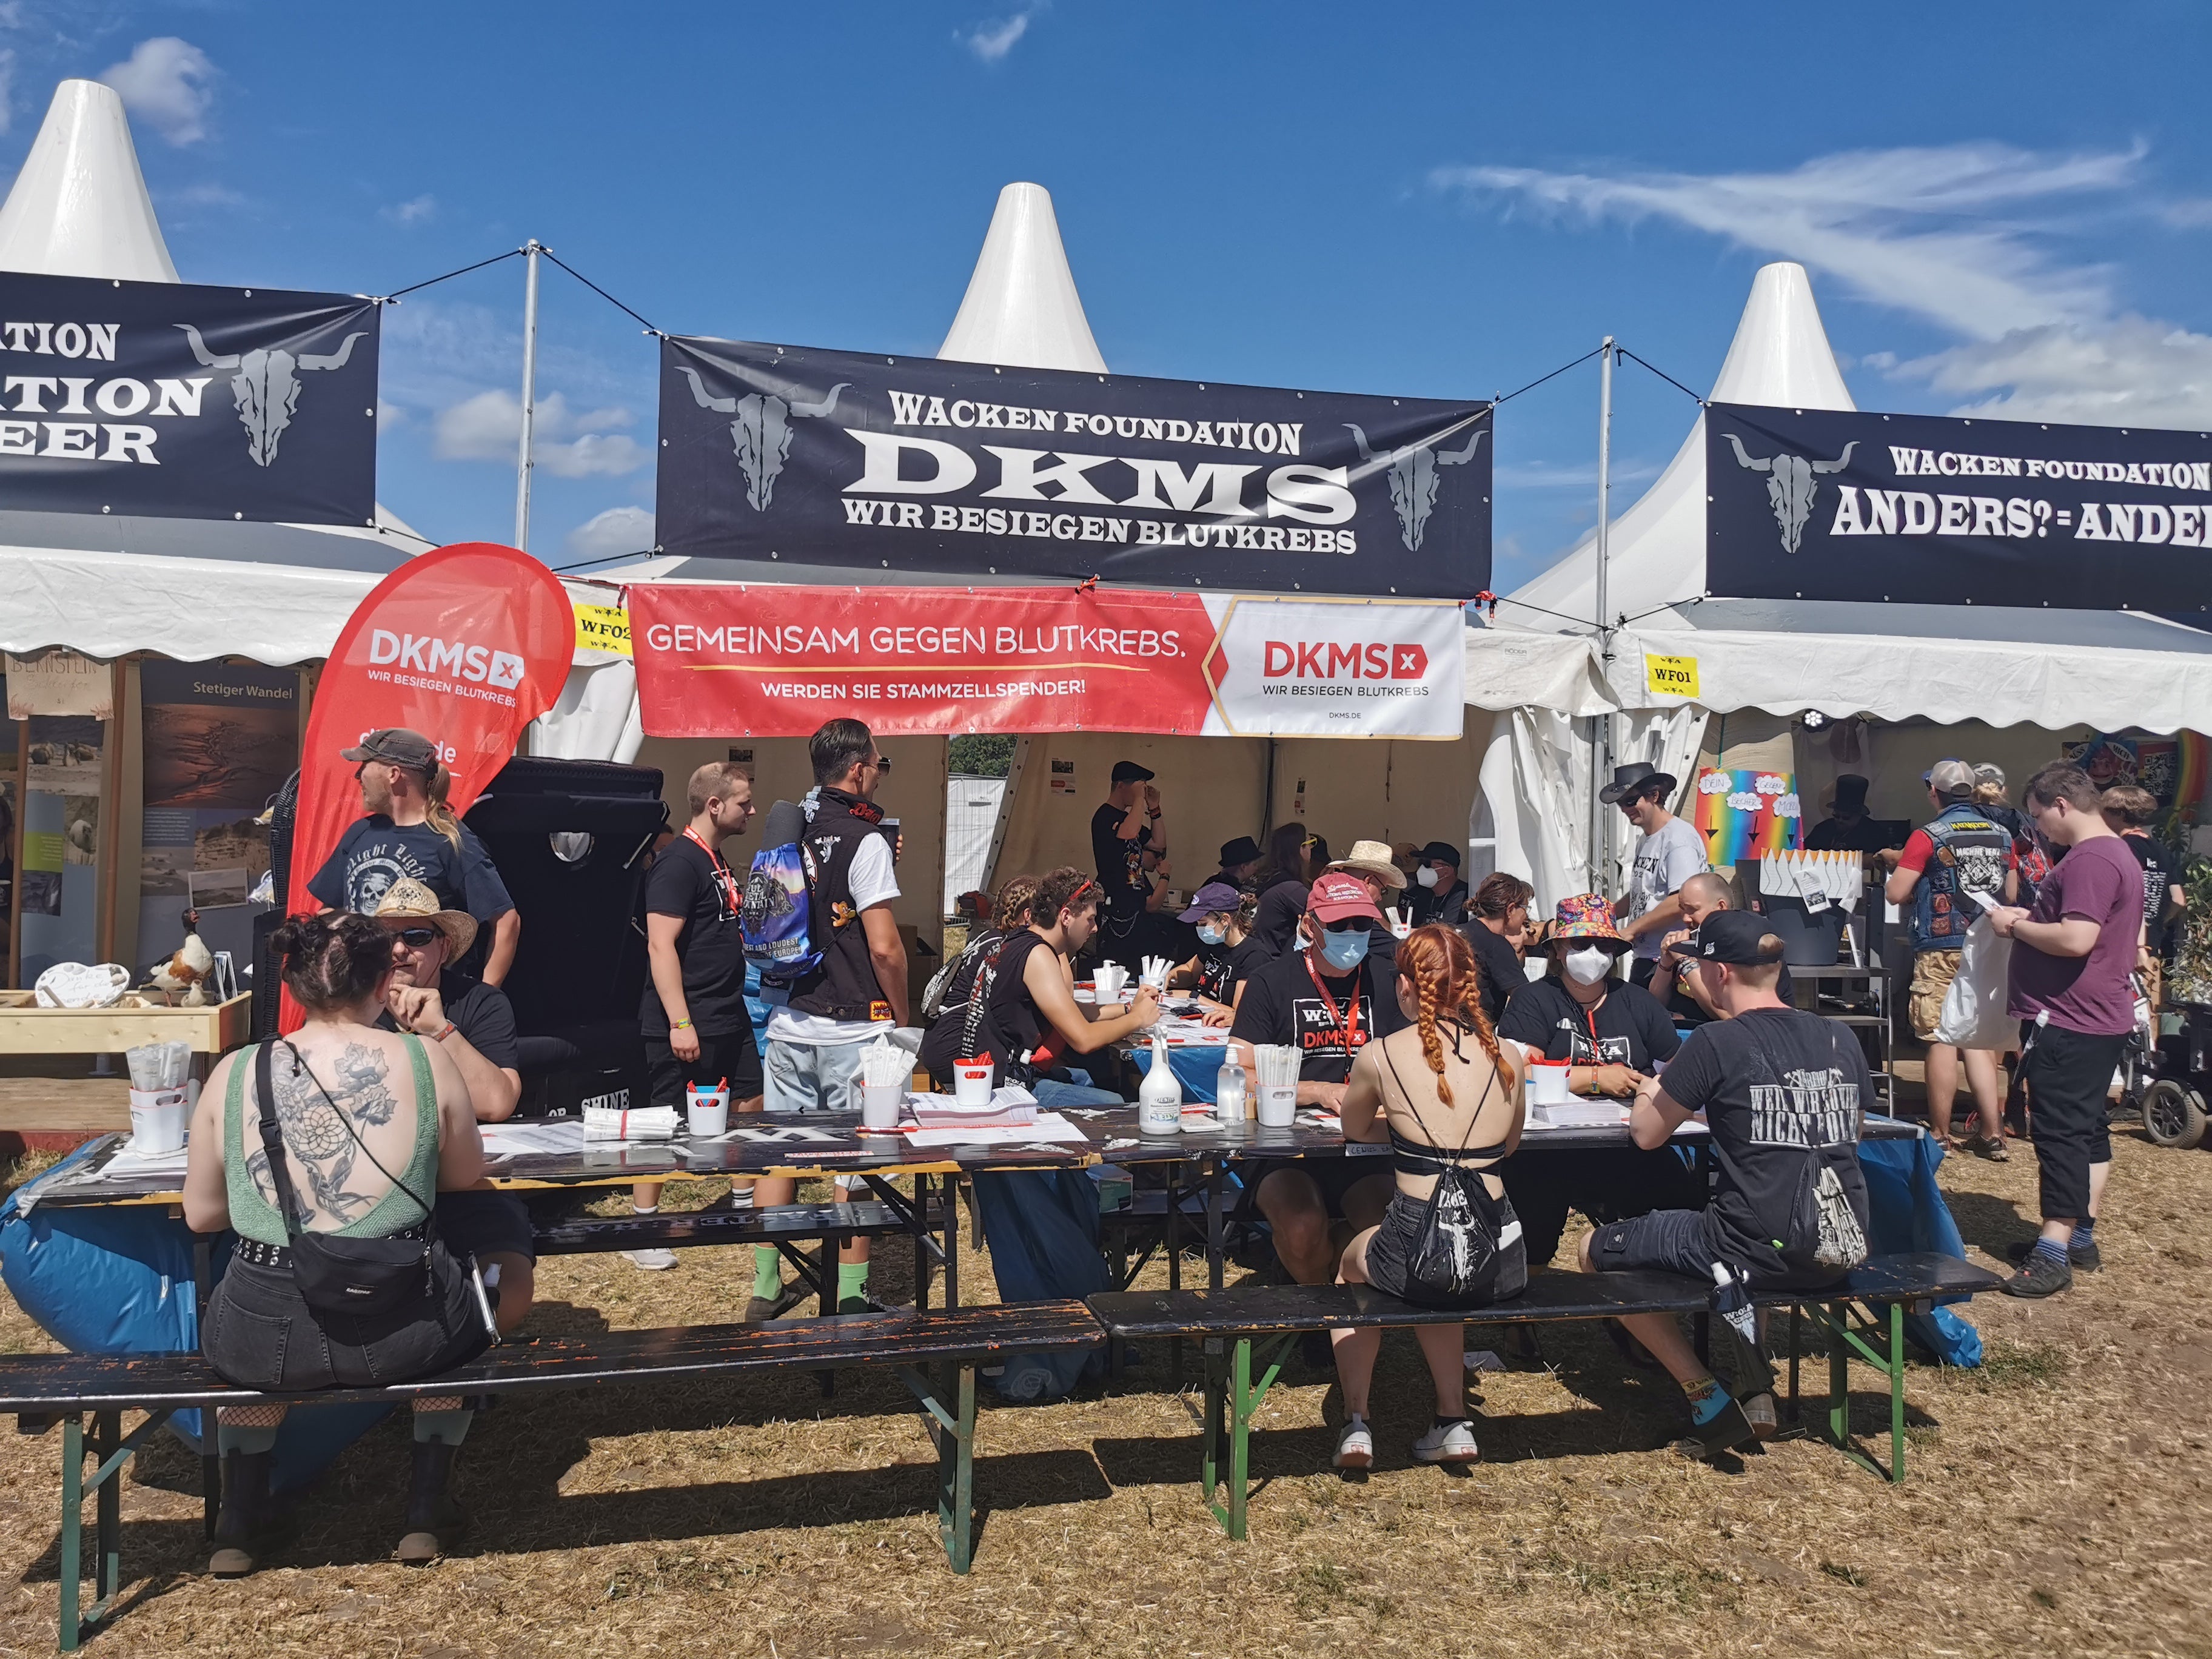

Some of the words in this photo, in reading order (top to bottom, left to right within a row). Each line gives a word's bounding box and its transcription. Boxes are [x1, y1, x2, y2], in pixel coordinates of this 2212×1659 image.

[0, 375, 213, 417] TION
[888, 390, 1059, 432] WACKEN
[1064, 411, 1304, 456] FOUNDATION
[842, 428, 1357, 526] DKMS
[1888, 446, 2023, 477] WACKEN
[2026, 460, 2211, 491] FOUNDATION
[842, 498, 925, 529] WIR
[930, 505, 1132, 545] BESIEGEN
[1136, 520, 1356, 555] BLUTKREBS
[1829, 485, 2052, 539] ANDERS?
[2074, 503, 2212, 548] ANDE
[581, 618, 631, 640] WF02
[646, 623, 859, 654] GEMEINSAM
[869, 626, 985, 654] GEGEN
[996, 625, 1187, 659] BLUTKREBS.
[369, 629, 490, 682] DKMS
[1264, 640, 1390, 680] DKMS
[193, 682, 243, 697] Stetiger
[246, 685, 293, 700] Wandel
[367, 669, 390, 682] WIR
[394, 673, 452, 694] BESIEGEN
[455, 685, 517, 708] BLUTKREBS
[761, 682, 848, 699] WERDEN
[852, 684, 881, 699] SIE
[886, 679, 1087, 699] STAMMZELLSPENDER!
[1262, 685, 1287, 696] WIR
[1292, 686, 1353, 697] BESIEGEN
[1357, 686, 1429, 697] BLUTKREBS
[1654, 668, 1692, 683] WF01
[1704, 779, 1724, 788] DEIN
[1731, 796, 1758, 807] BECHER
[755, 943, 767, 951] AND
[769, 937, 799, 949] LOUDEST
[774, 946, 802, 957] EUROPE!
[581, 1088, 629, 1116] SHINE
[1751, 1111, 1811, 1145] NICHT
